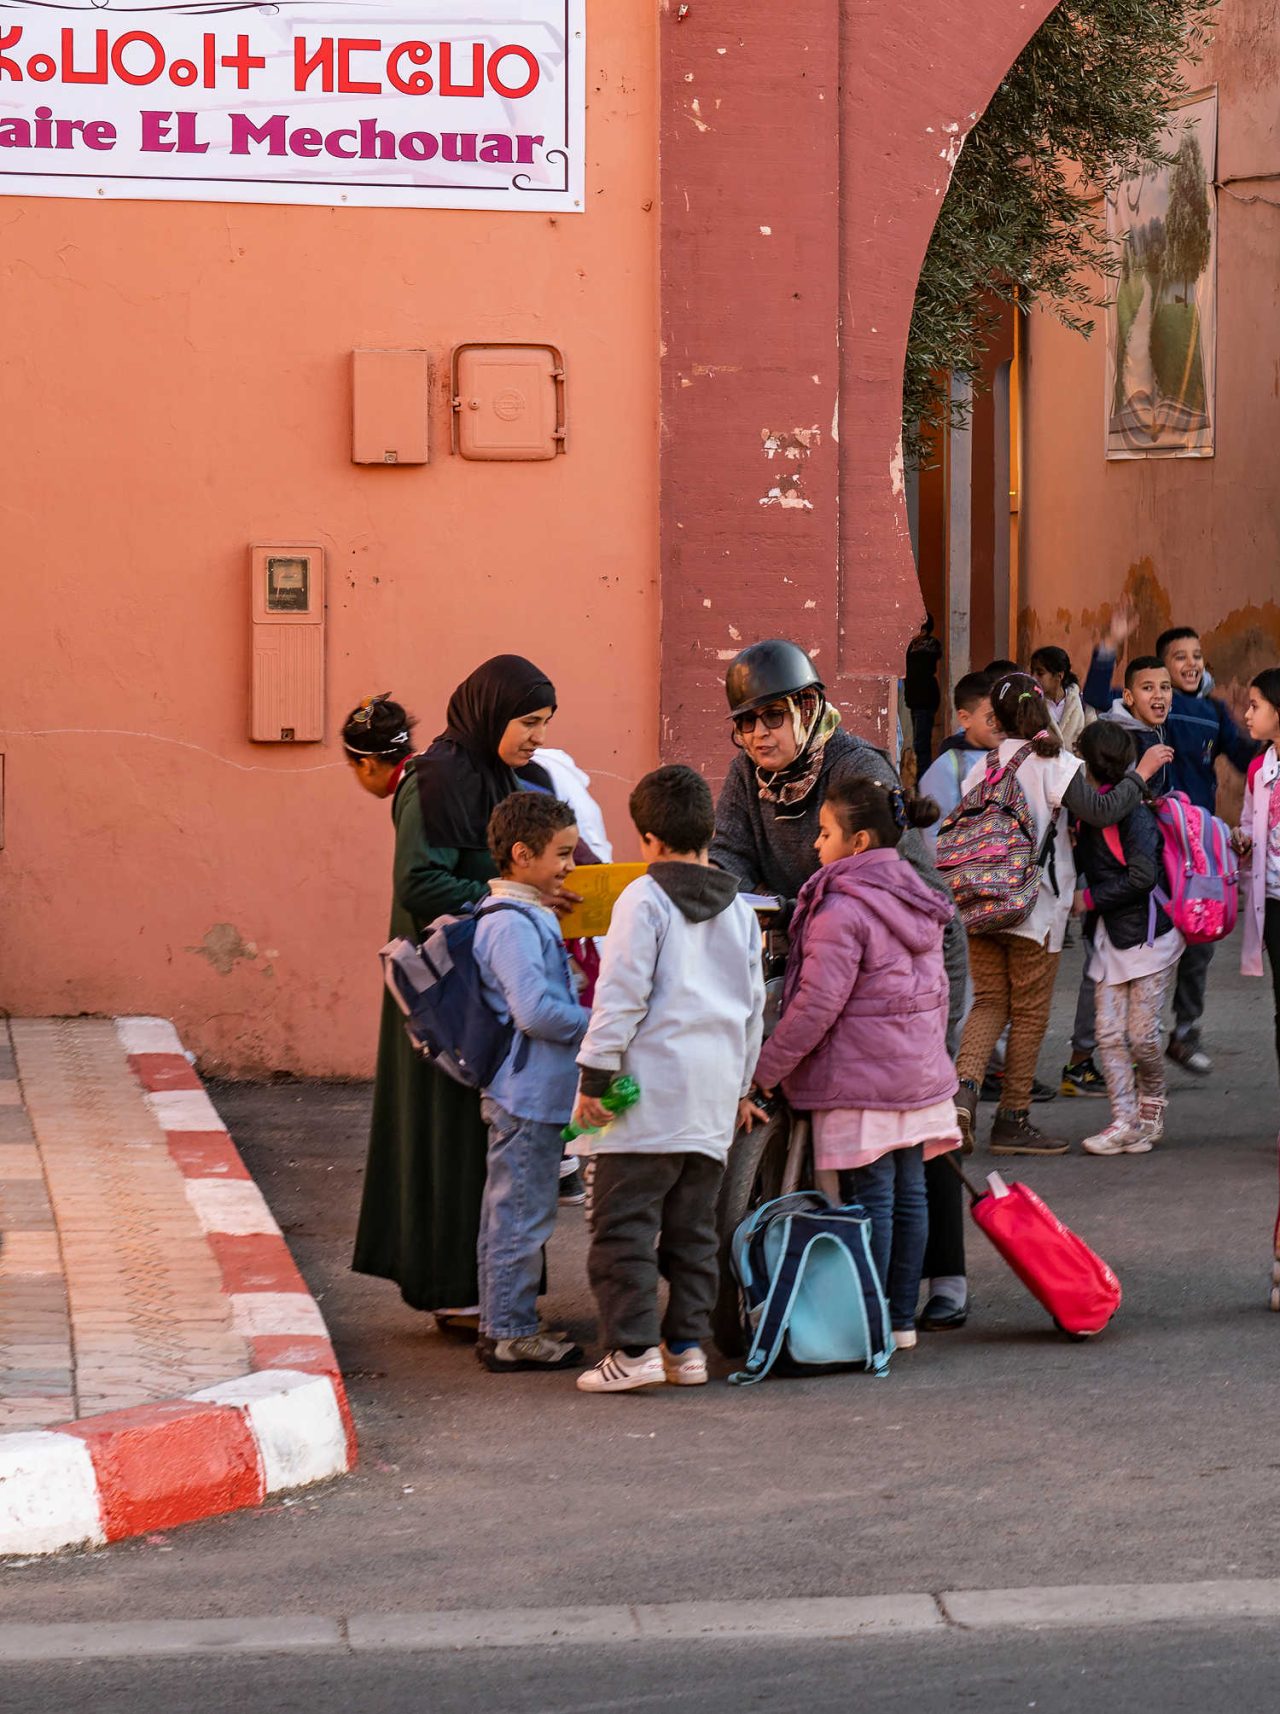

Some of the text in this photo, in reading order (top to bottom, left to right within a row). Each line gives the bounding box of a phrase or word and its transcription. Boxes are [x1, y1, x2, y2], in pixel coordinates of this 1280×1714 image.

[0, 106, 545, 164] aire EL Mechouar
